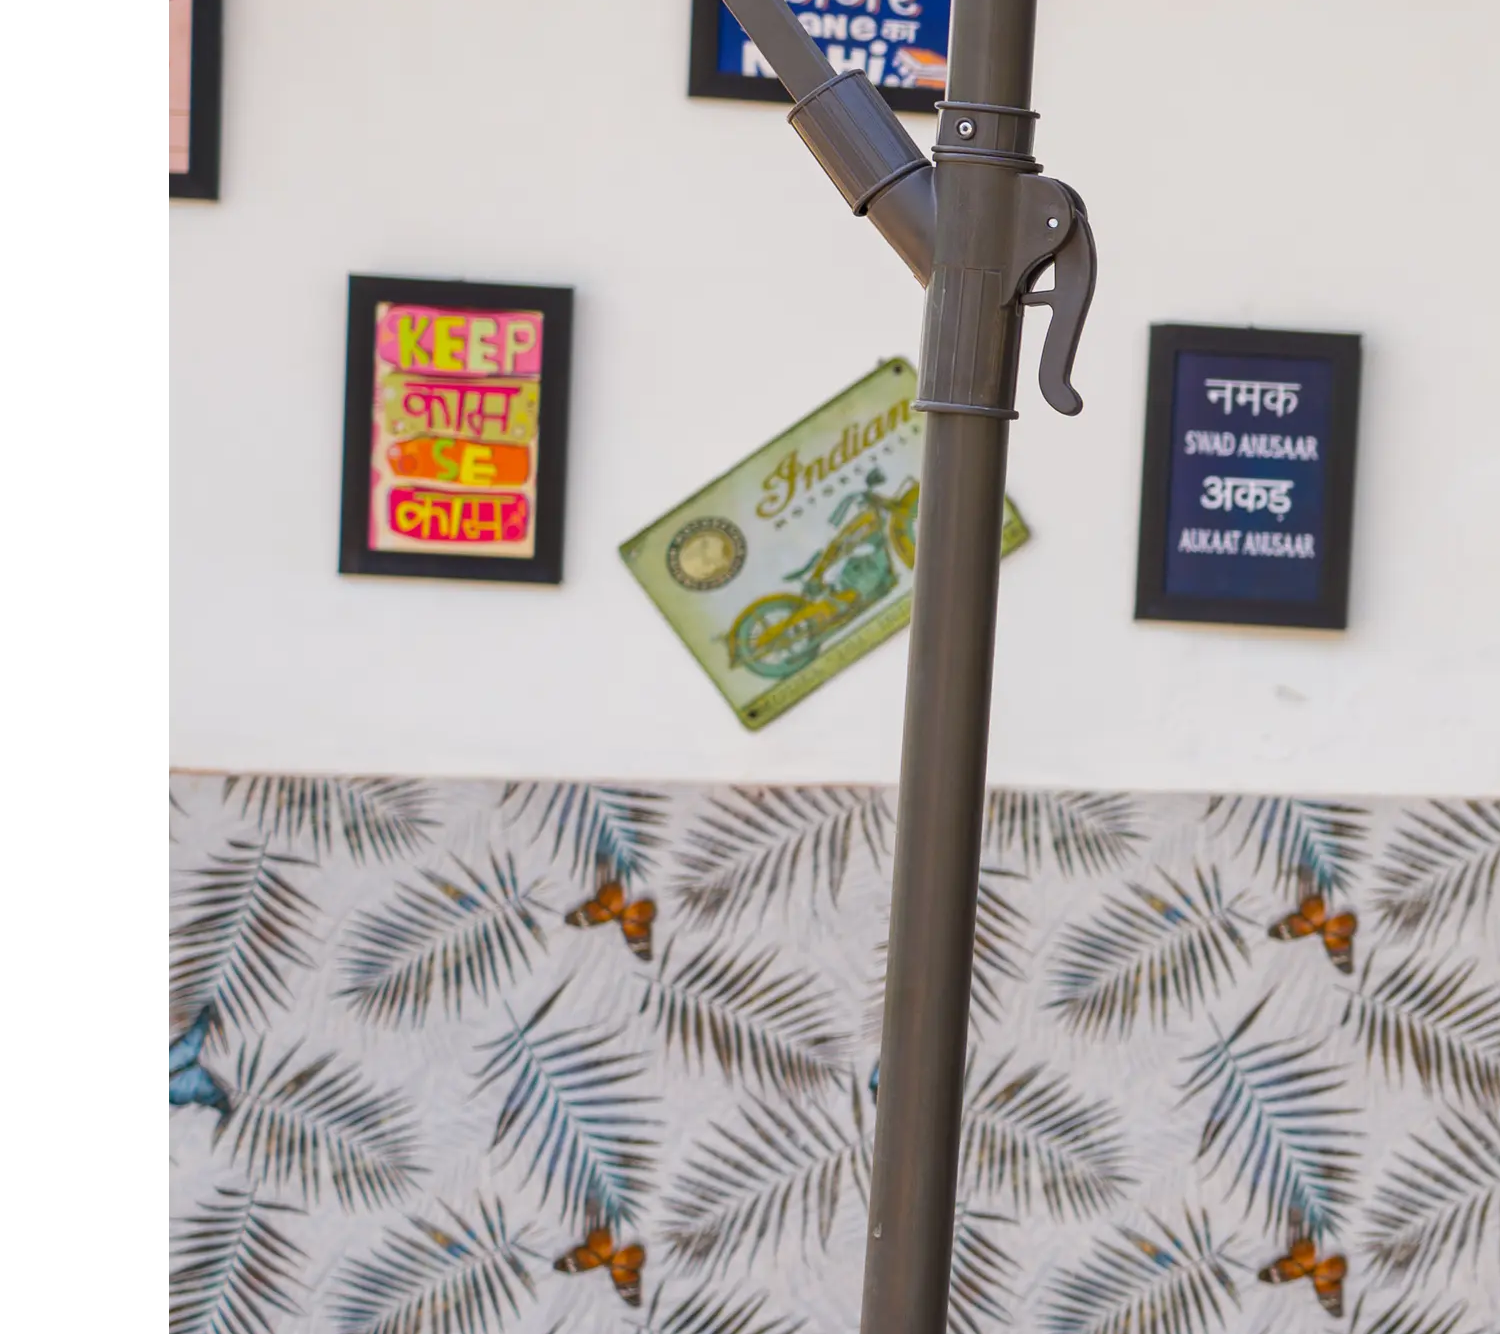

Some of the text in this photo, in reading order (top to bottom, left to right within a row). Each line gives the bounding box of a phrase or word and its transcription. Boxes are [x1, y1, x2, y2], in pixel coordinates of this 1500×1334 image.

[398, 314, 537, 373] KEEP
[402, 382, 522, 436] काम
[1204, 378, 1302, 418] नमक
[432, 437, 497, 487] SE
[755, 396, 913, 520] Indian
[1184, 429, 1319, 461] SWAD ANUSAAR
[395, 490, 516, 540] काम
[1200, 474, 1294, 523] अकड़
[1242, 531, 1315, 559] ANUSAAR
